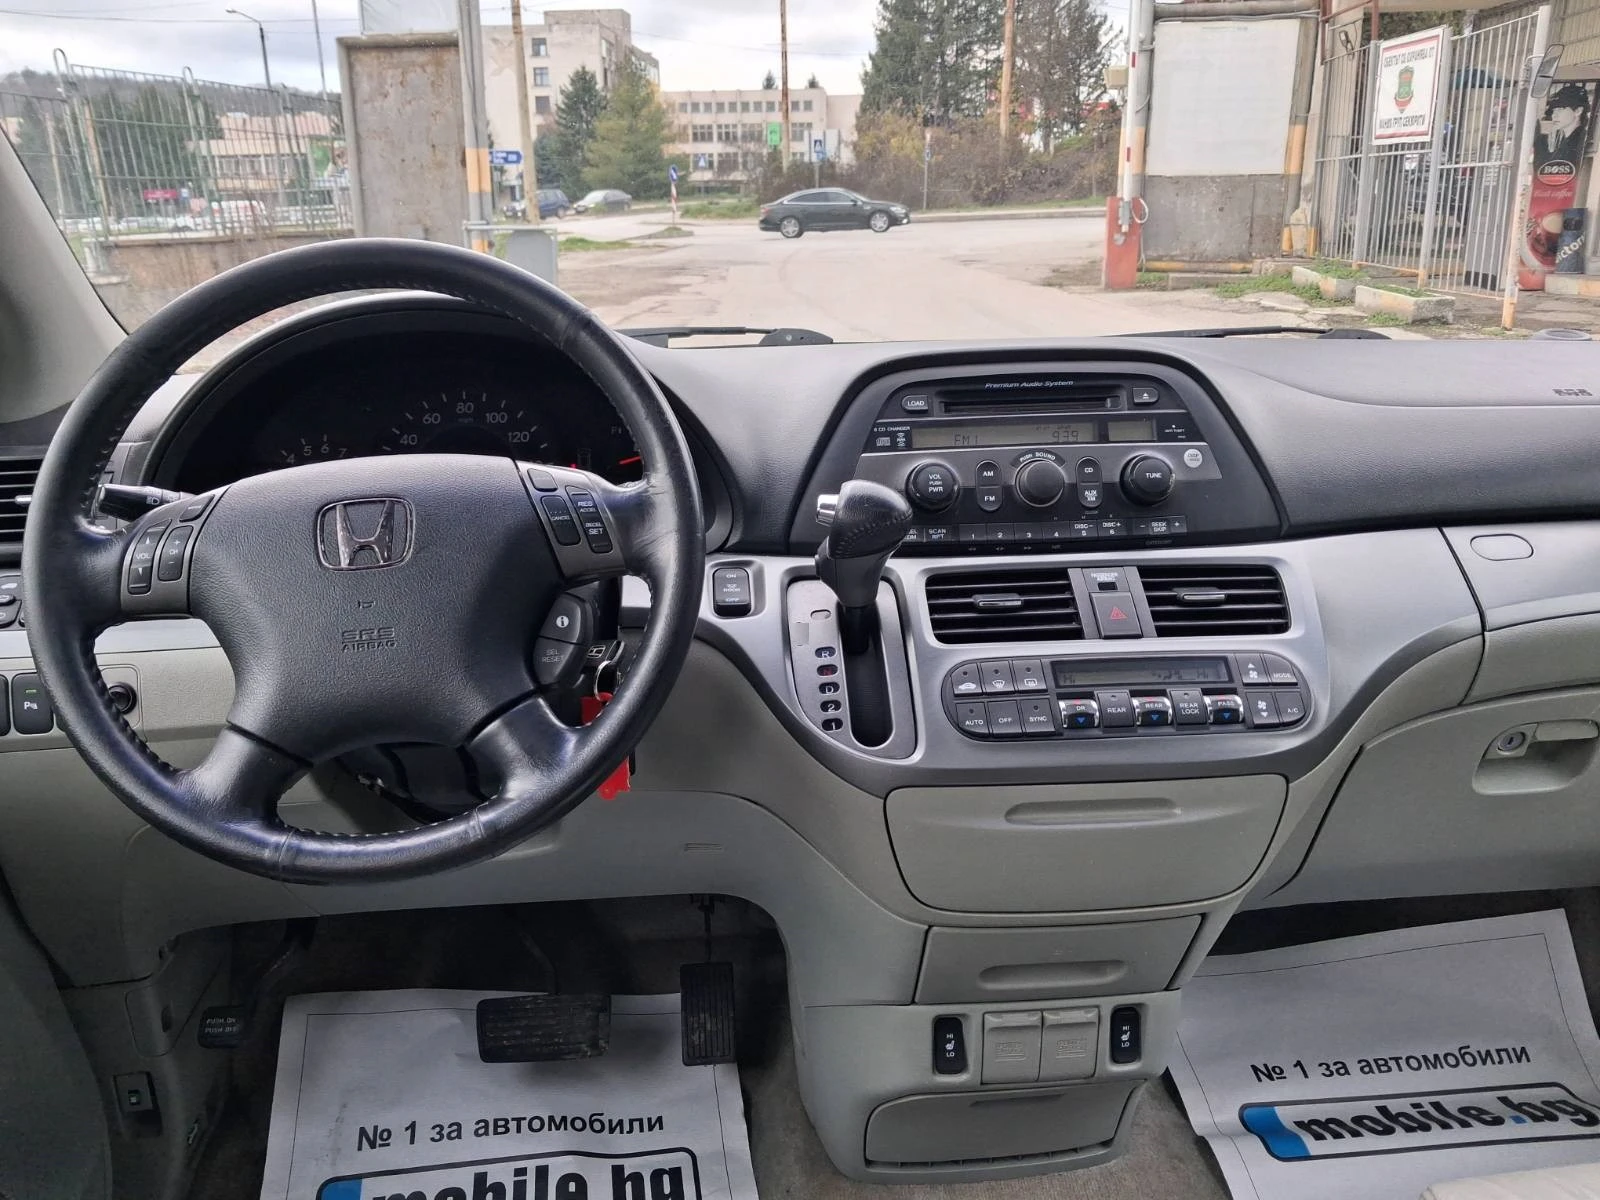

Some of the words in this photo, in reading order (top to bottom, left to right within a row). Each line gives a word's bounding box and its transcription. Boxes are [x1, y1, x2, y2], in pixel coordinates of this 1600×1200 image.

[1543, 165, 1571, 175] BOSS
[1020, 380, 1044, 388] Audio
[1044, 380, 1074, 388] System
[455, 402, 475, 414] 80
[422, 412, 441, 425] 60
[485, 411, 508, 425] 100
[399, 433, 418, 446] 40
[508, 430, 530, 444] 120
[303, 445, 312, 457] 5
[320, 442, 329, 454] 6
[588, 527, 604, 535] SET
[136, 552, 151, 560] VOL
[342, 641, 397, 653] AIRBAG
[541, 655, 564, 663] RESET
[825, 685, 835, 695] D
[827, 703, 836, 713] 2
[1029, 715, 1048, 723] SYNC
[1251, 1062, 1287, 1083] №
[1294, 1059, 1309, 1080] 1
[1318, 1060, 1350, 1079] за
[1359, 1045, 1532, 1075] автомобили
[1293, 1095, 1600, 1142] mobile.bg
[356, 1125, 392, 1152] №
[403, 1120, 417, 1145] 1
[430, 1121, 463, 1143] за
[473, 1111, 665, 1138] автомобили
[372, 1163, 688, 1200] bilebg
